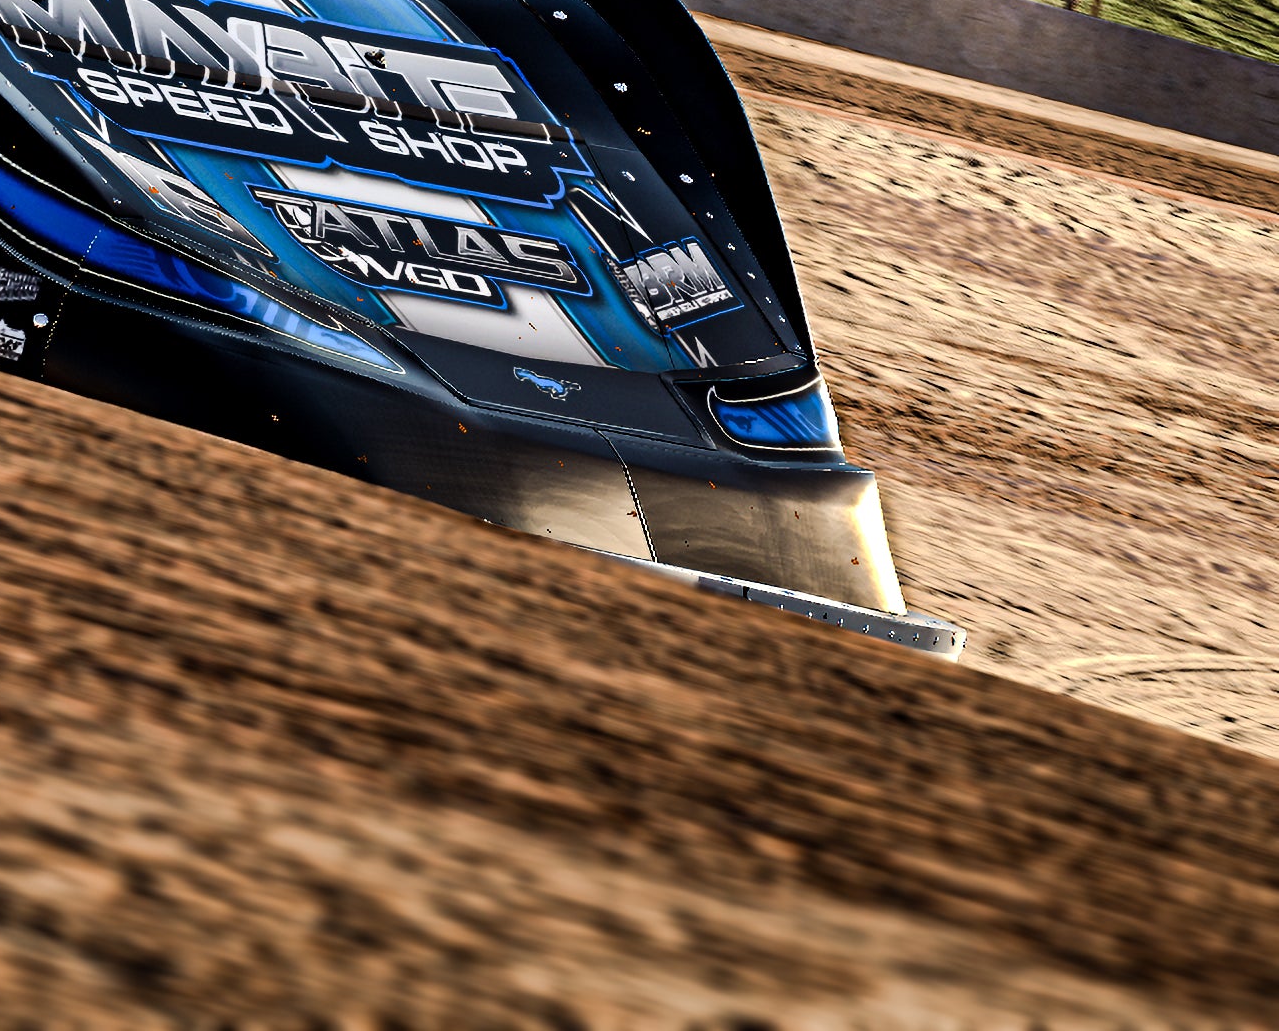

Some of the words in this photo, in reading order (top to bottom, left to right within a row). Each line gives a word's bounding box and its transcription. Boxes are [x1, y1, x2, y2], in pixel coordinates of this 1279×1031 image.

[77, 67, 294, 136] SPEED
[359, 119, 528, 173] SHOP
[250, 191, 578, 284] ATLAS
[358, 256, 492, 297] VGD
